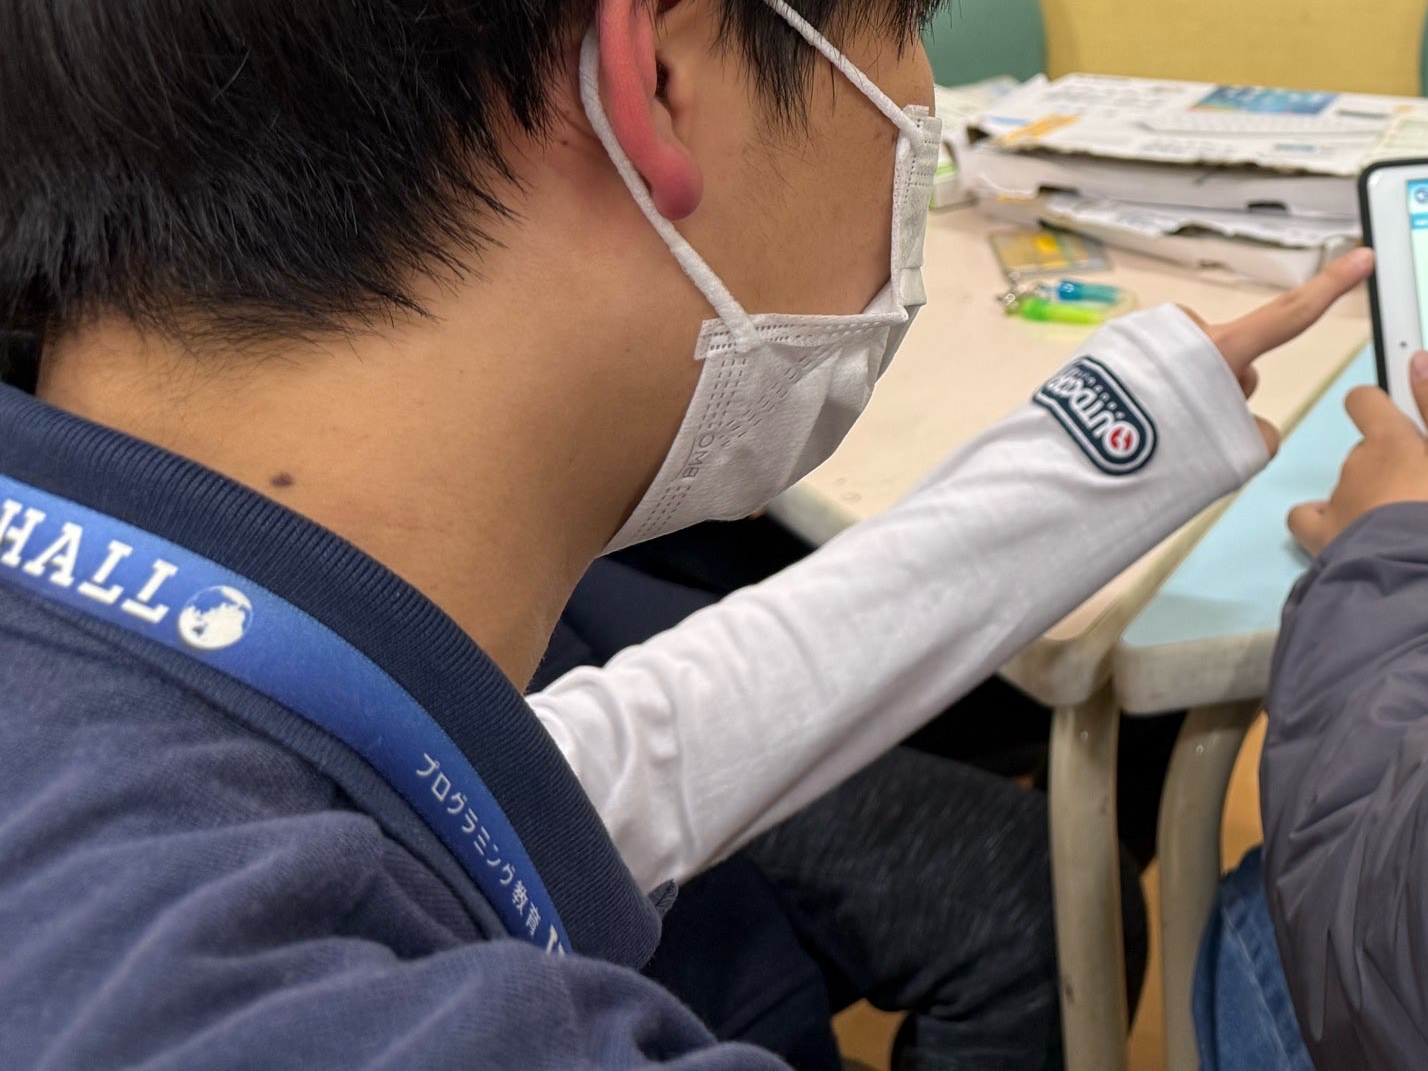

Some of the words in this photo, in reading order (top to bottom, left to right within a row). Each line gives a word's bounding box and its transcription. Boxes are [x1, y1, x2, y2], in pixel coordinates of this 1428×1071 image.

[415, 751, 542, 938] プログラミング教育
